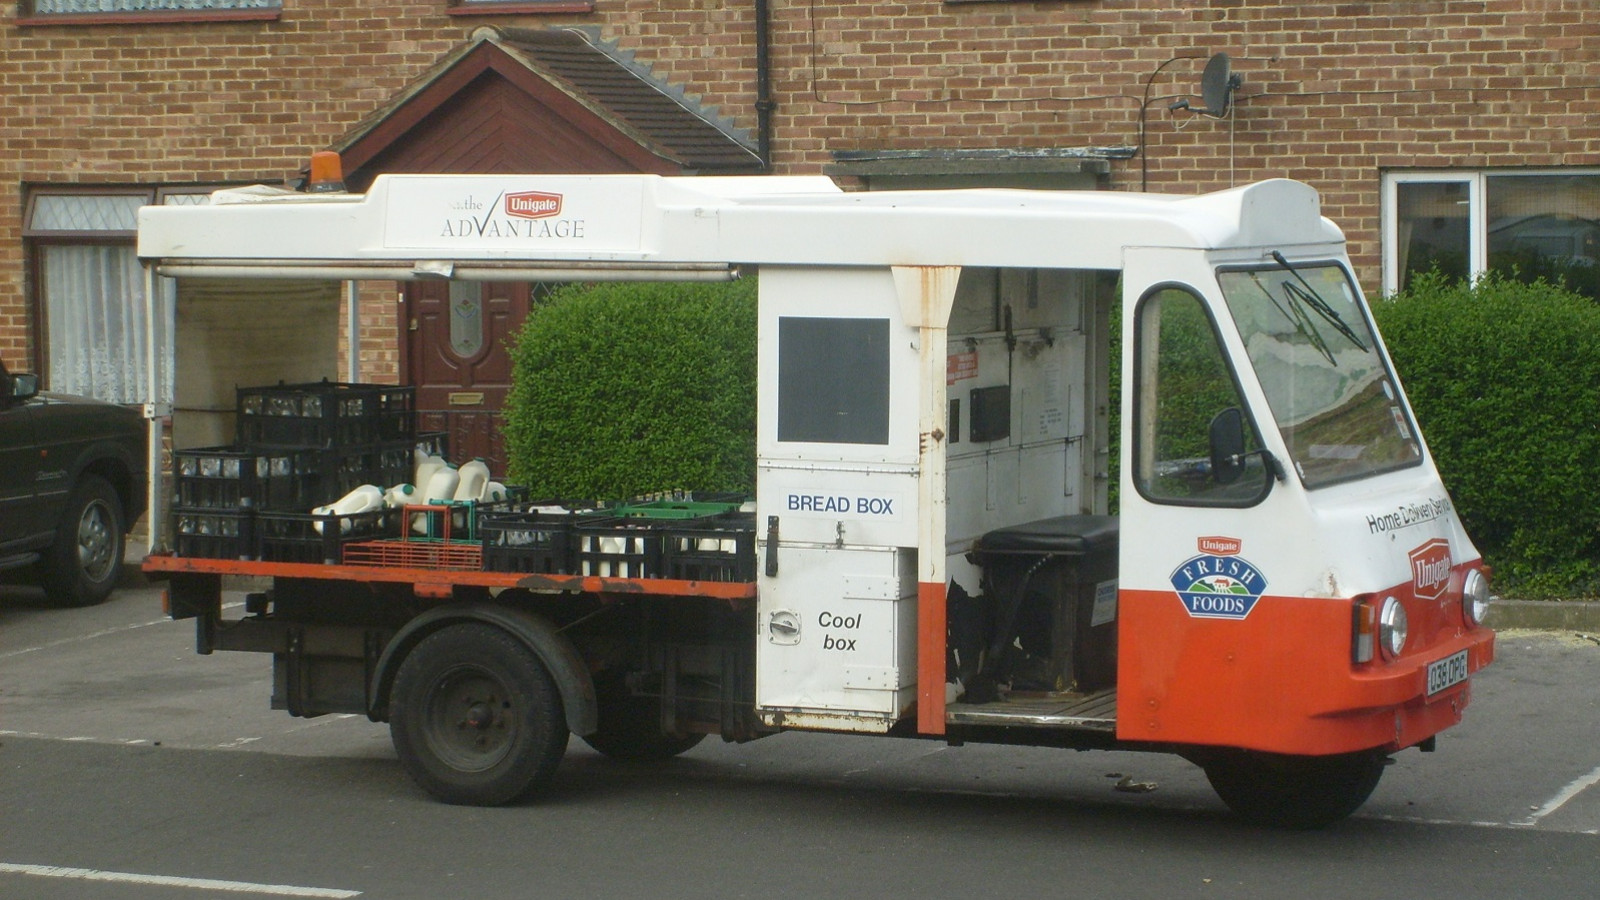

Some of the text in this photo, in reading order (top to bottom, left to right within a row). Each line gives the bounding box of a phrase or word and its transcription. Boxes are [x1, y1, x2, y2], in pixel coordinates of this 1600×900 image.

[511, 198, 557, 213] Unigate
[788, 494, 893, 515] BREAD BOX
[1366, 511, 1402, 534] Home
[1202, 540, 1238, 552] Unigate
[1182, 558, 1256, 585] FRESH
[1415, 553, 1450, 590] Unigate
[1192, 596, 1245, 613] FOODS
[818, 611, 862, 629] Cool
[823, 634, 857, 651] box
